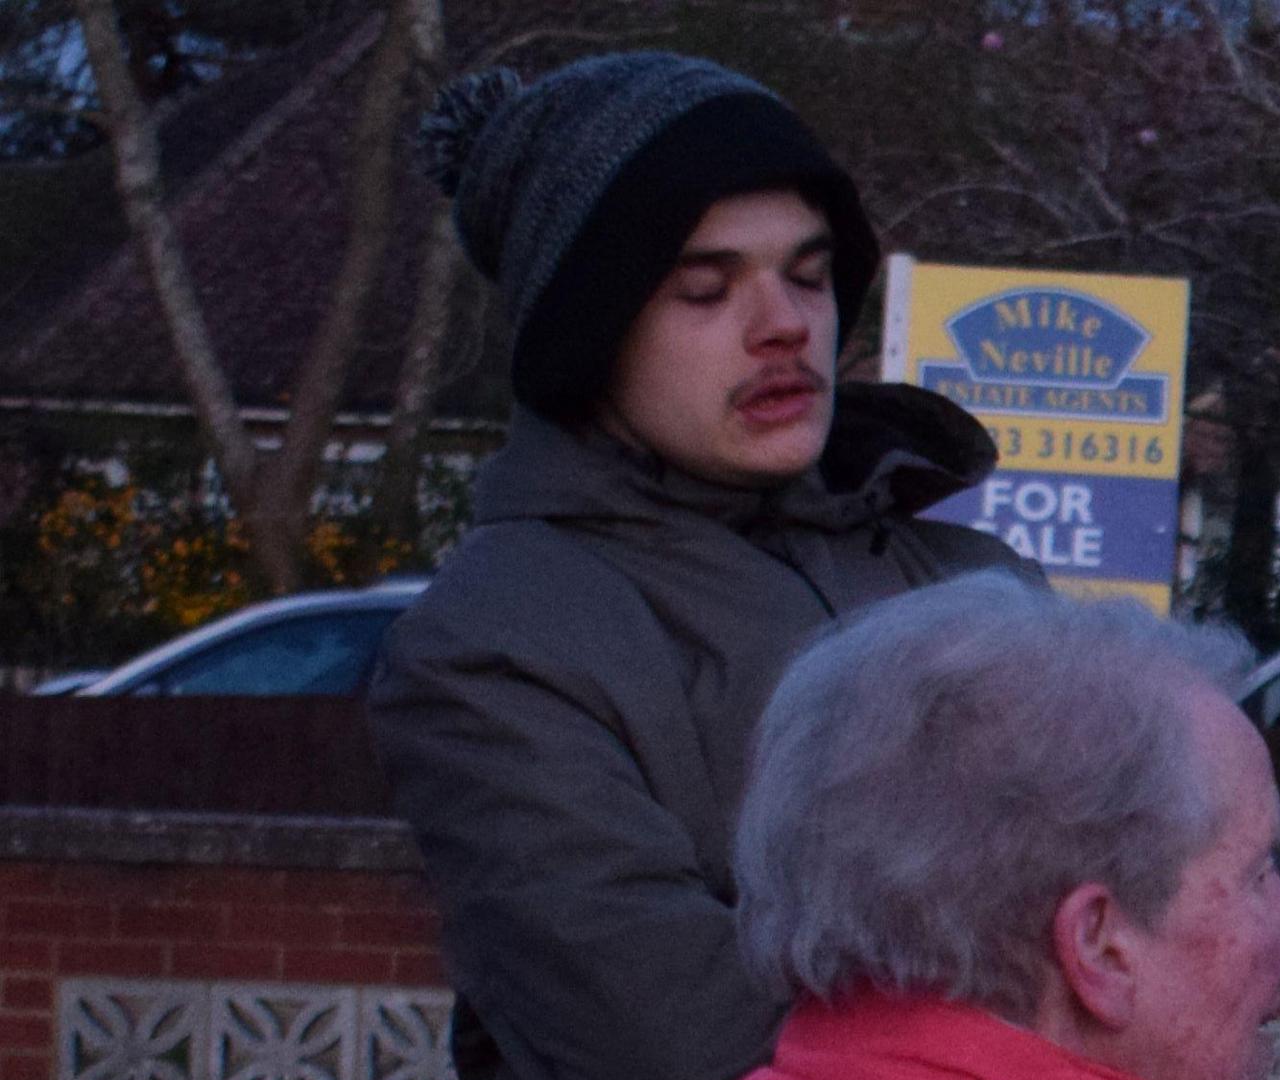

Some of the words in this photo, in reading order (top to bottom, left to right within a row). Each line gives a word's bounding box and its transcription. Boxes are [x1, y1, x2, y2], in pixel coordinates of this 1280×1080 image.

[993, 296, 1103, 339] Mike
[978, 338, 1112, 379] Neville
[937, 378, 1036, 410] ESTATE
[1045, 384, 1149, 415] AGENTS
[1037, 428, 1164, 464] 316316
[981, 480, 1094, 524] FOR
[971, 519, 1105, 568] ALE
